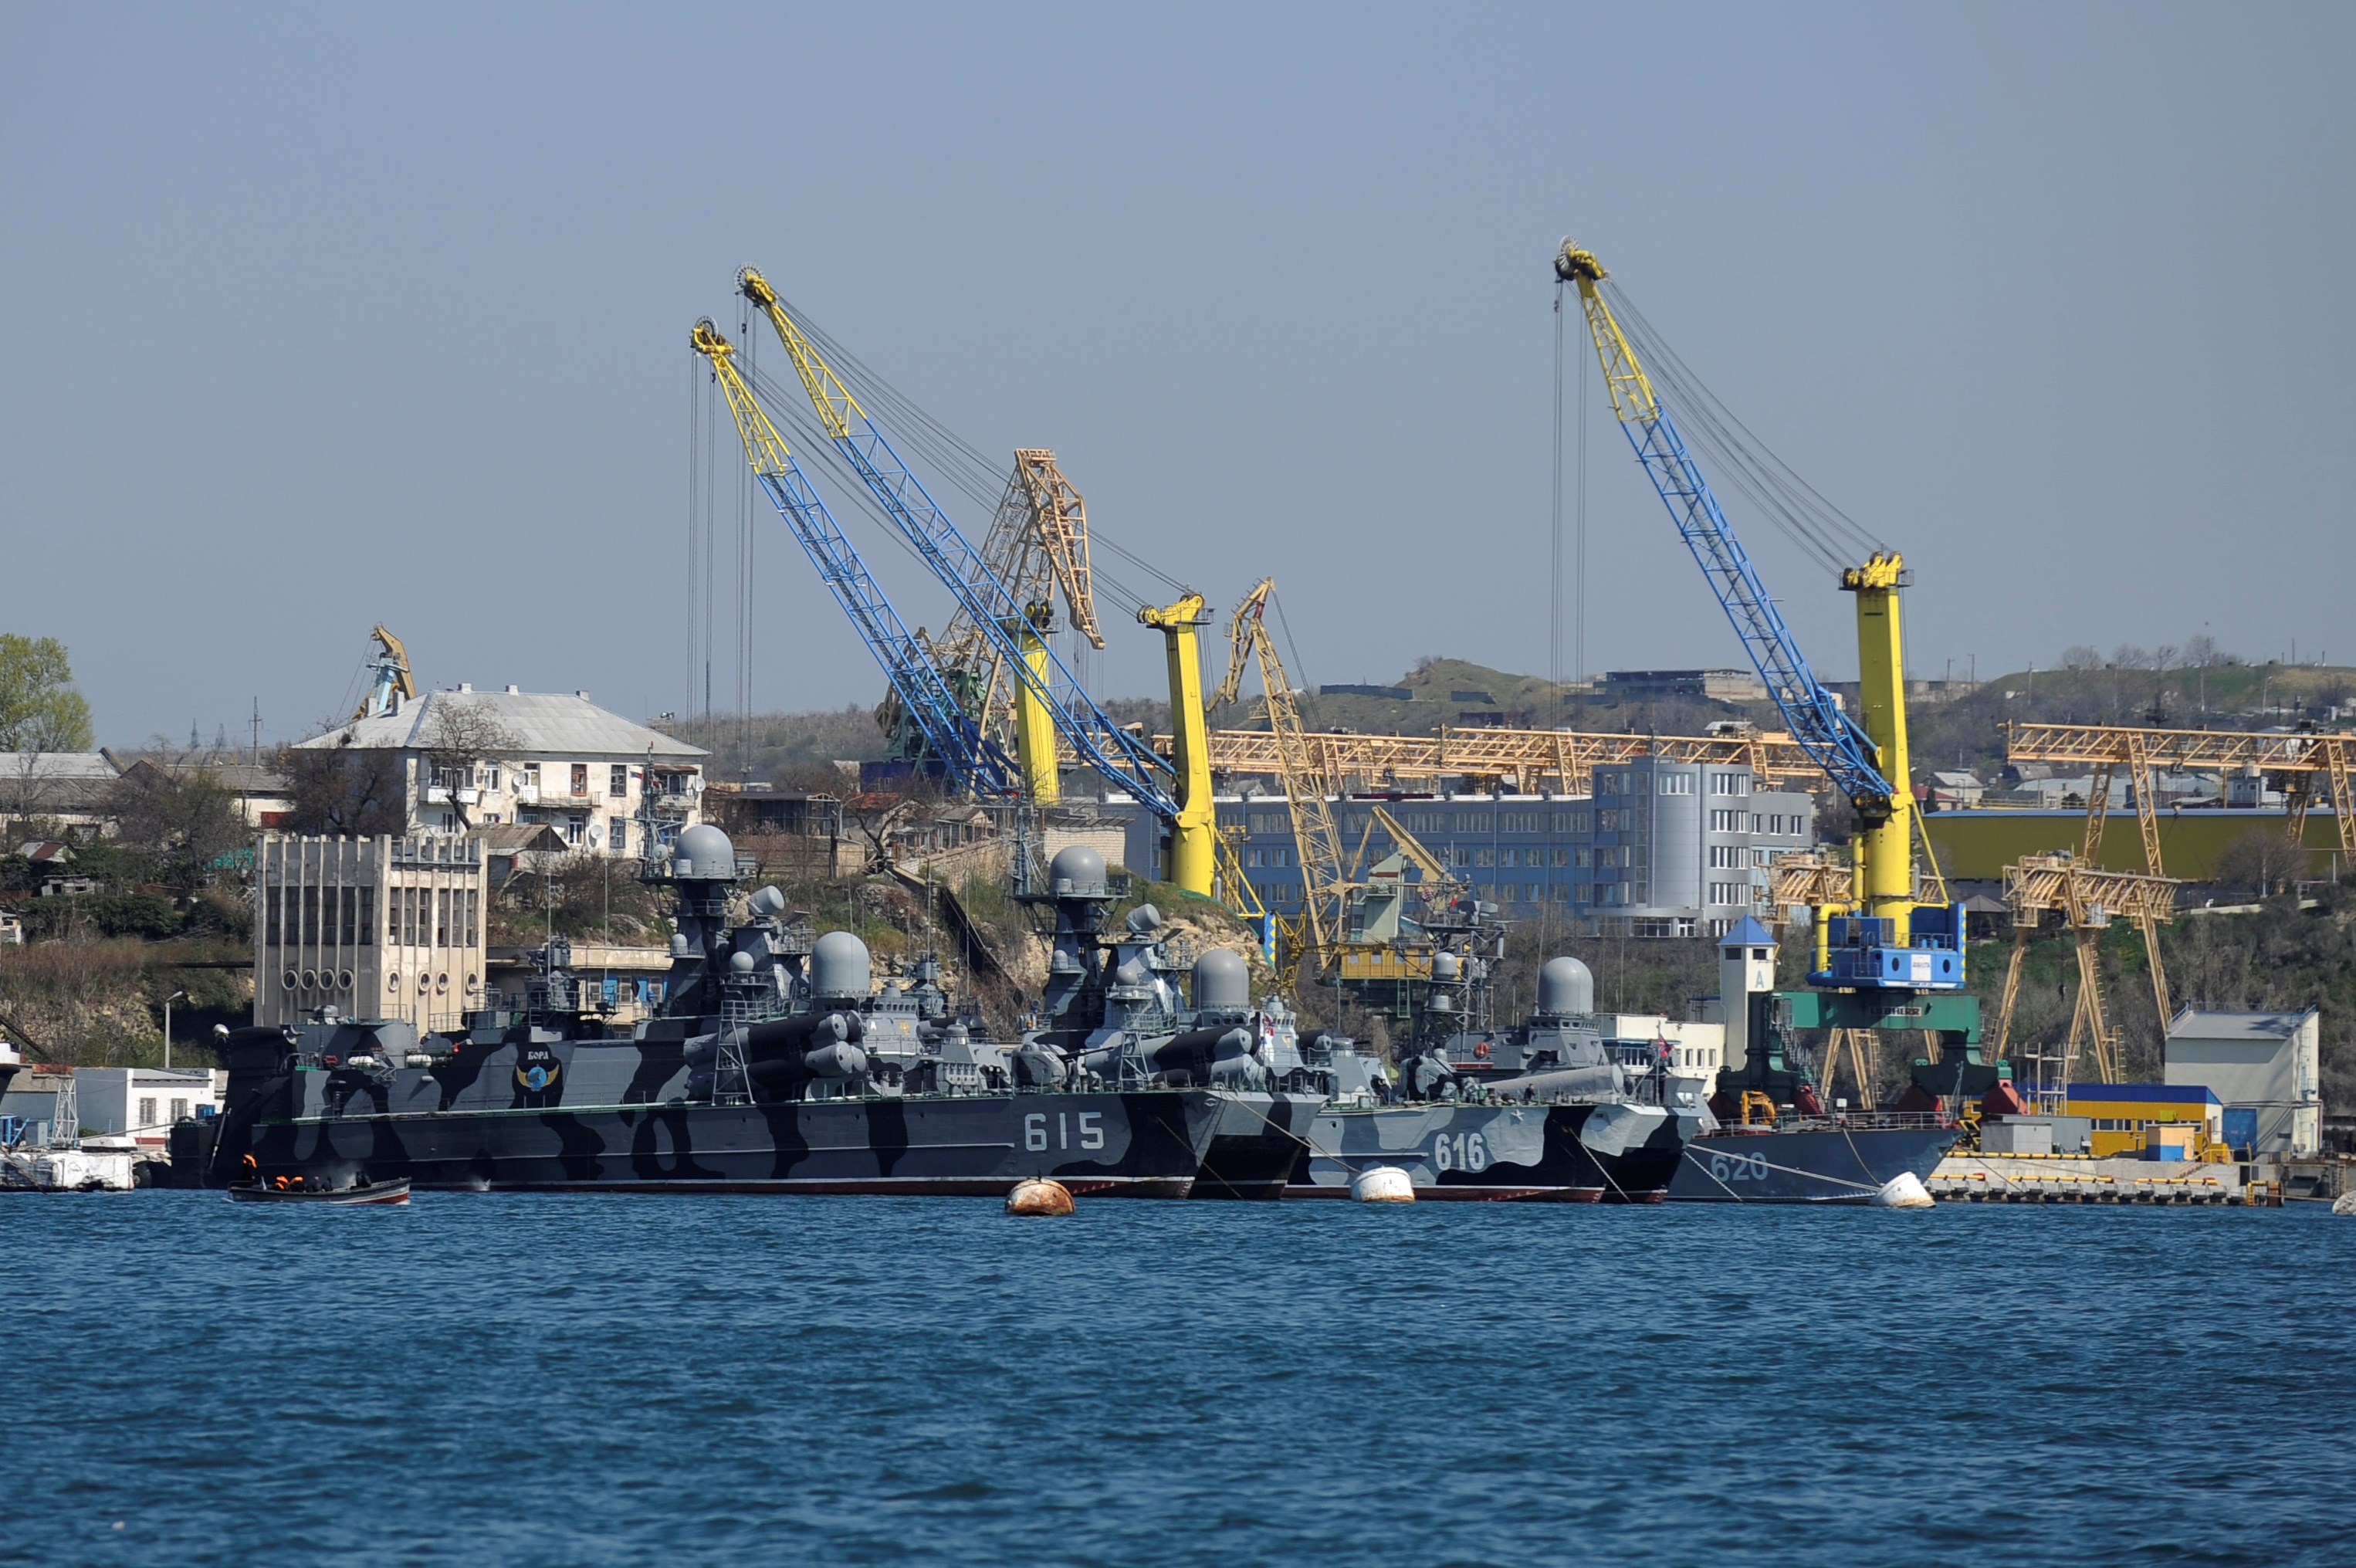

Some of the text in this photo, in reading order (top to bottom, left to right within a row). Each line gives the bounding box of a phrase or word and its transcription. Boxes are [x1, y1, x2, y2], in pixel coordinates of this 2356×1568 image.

[527, 1051, 549, 1060] БОРА
[1024, 1112, 1104, 1151] 615
[1434, 1133, 1485, 1171] 616
[1711, 1152, 1769, 1182] 620
